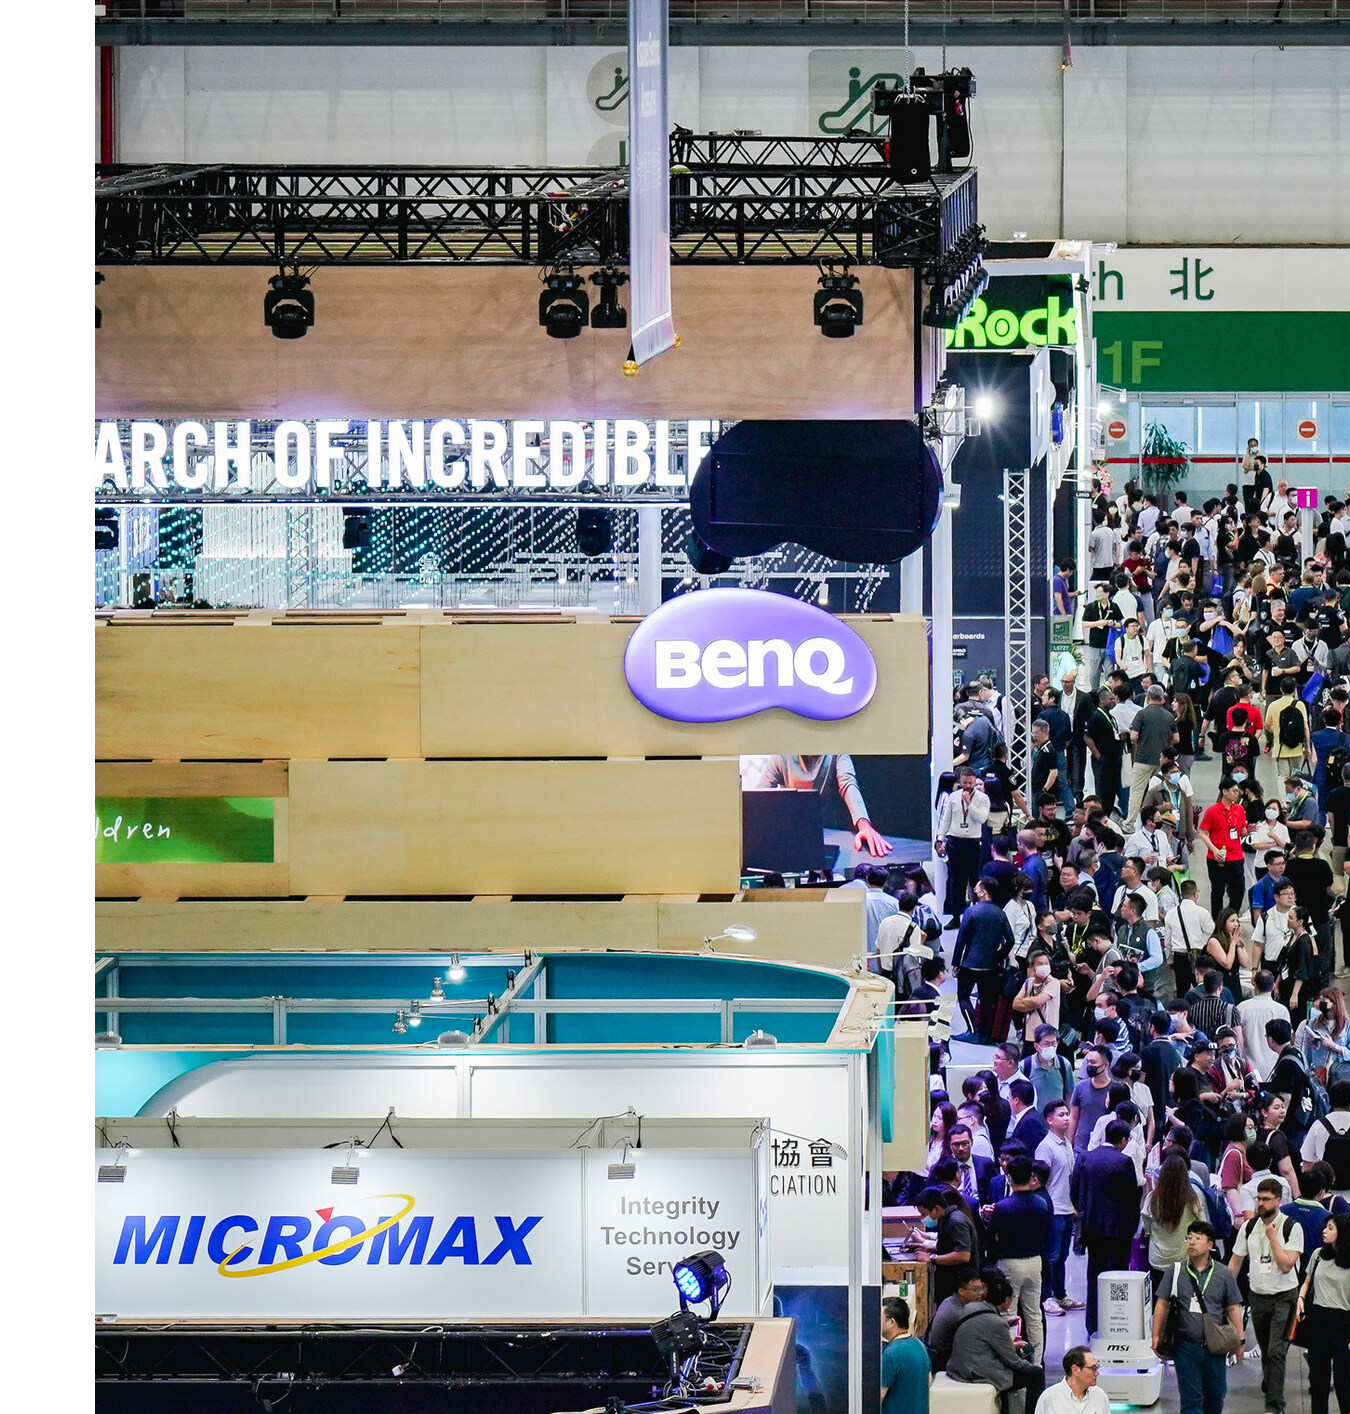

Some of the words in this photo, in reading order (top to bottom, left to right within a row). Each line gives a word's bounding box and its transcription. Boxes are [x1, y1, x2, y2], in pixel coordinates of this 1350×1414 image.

[1169, 257, 1215, 301] 北
[1102, 340, 1163, 384] 1F
[273, 421, 351, 488] OF
[654, 637, 854, 695] BenQ
[771, 1138, 834, 1168] 協會
[620, 1196, 720, 1220] Integrity
[113, 1213, 544, 1267] MICROMAX
[600, 1227, 741, 1250] Technology
[1107, 1344, 1130, 1352] msi
